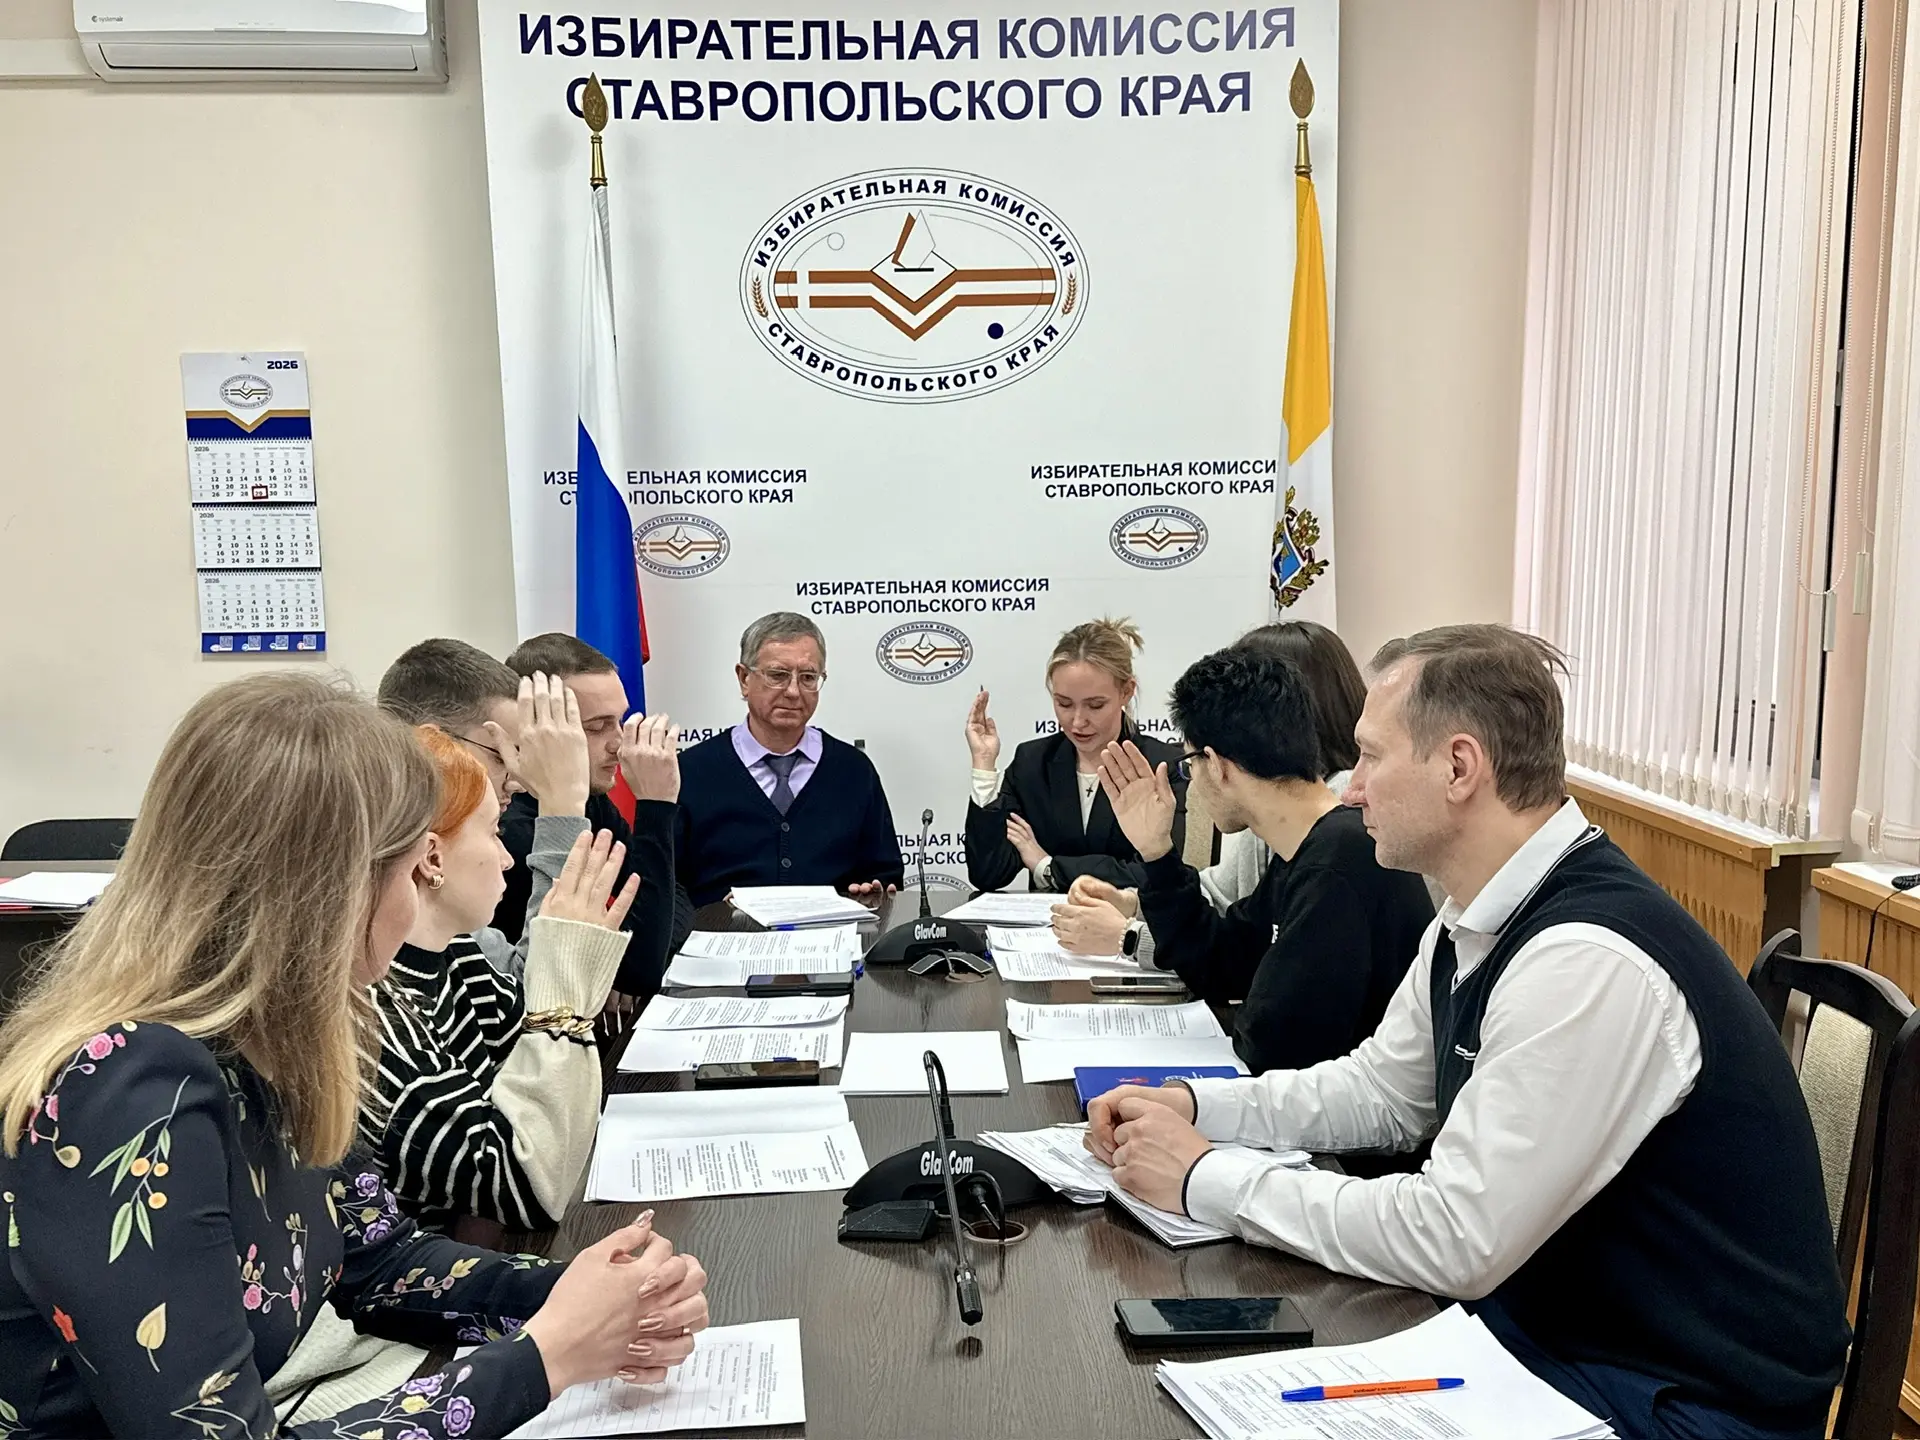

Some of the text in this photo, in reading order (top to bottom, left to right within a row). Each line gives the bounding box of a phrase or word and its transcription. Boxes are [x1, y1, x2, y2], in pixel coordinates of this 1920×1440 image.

[520, 8, 1294, 60] ИЗБИРАТЕЛЬНАЯ КОМИССИЯ
[566, 72, 1250, 122] СТАВРОПОЛЬСКОГО КРАЯ
[754, 179, 1075, 268] ИЗБИРАТЕЛЬНАЯ КОМИССИЯ
[266, 360, 298, 370] 2026
[768, 323, 1059, 391] СТАВРОПОЛЬСКОГО КРАЯ
[544, 470, 806, 486] ИЗБЕЛЬНАЯ КОМИССИЯ
[1032, 460, 1275, 479] ИЗБИРАТЕЛЬНАЯ КОМИССИ
[560, 488, 792, 505] СПОЛЬСКОГО КРАЯ
[1046, 480, 1273, 498] СТАВРОПОЛЬСКОГО КРАЯ
[797, 579, 1048, 595] ИЗБИРАТЕЛЬНАЯ КОМИССИЯ
[812, 598, 1035, 614] СТАВРОПОЛЬСКОГО КРАЯ
[914, 922, 946, 940] GlavCom
[920, 1150, 973, 1176] GlaCom
